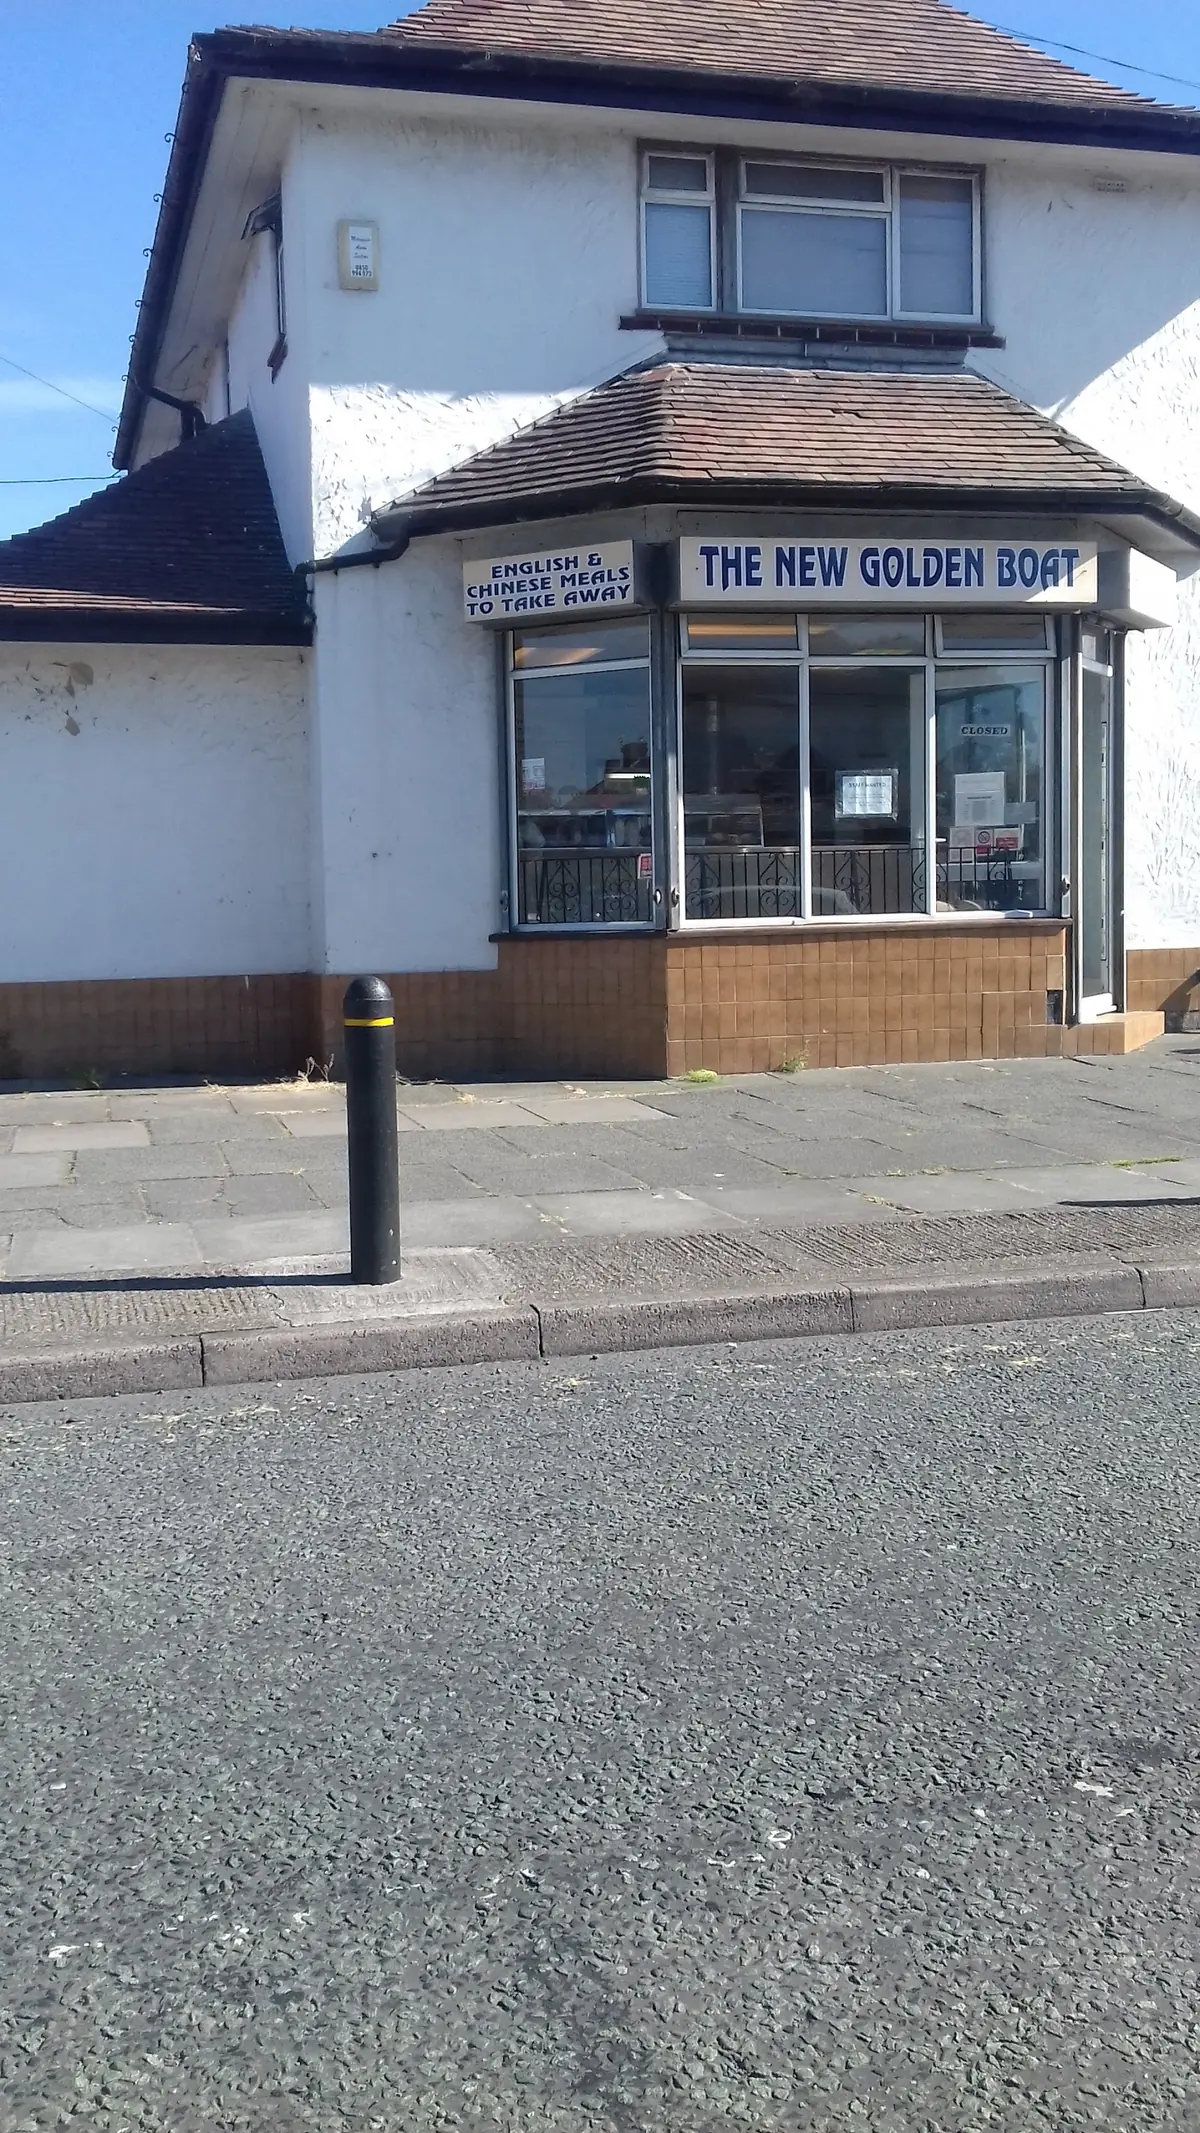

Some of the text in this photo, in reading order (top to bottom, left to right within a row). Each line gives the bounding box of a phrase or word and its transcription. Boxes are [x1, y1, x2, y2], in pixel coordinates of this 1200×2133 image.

[491, 552, 602, 579] ENGLISH &
[699, 545, 1080, 592] THE NEW GOLDEN BOAT
[466, 566, 630, 599] CHINESE MEALS
[466, 584, 631, 616] TO TAKE AWAY
[961, 726, 1008, 735] CLOSED
